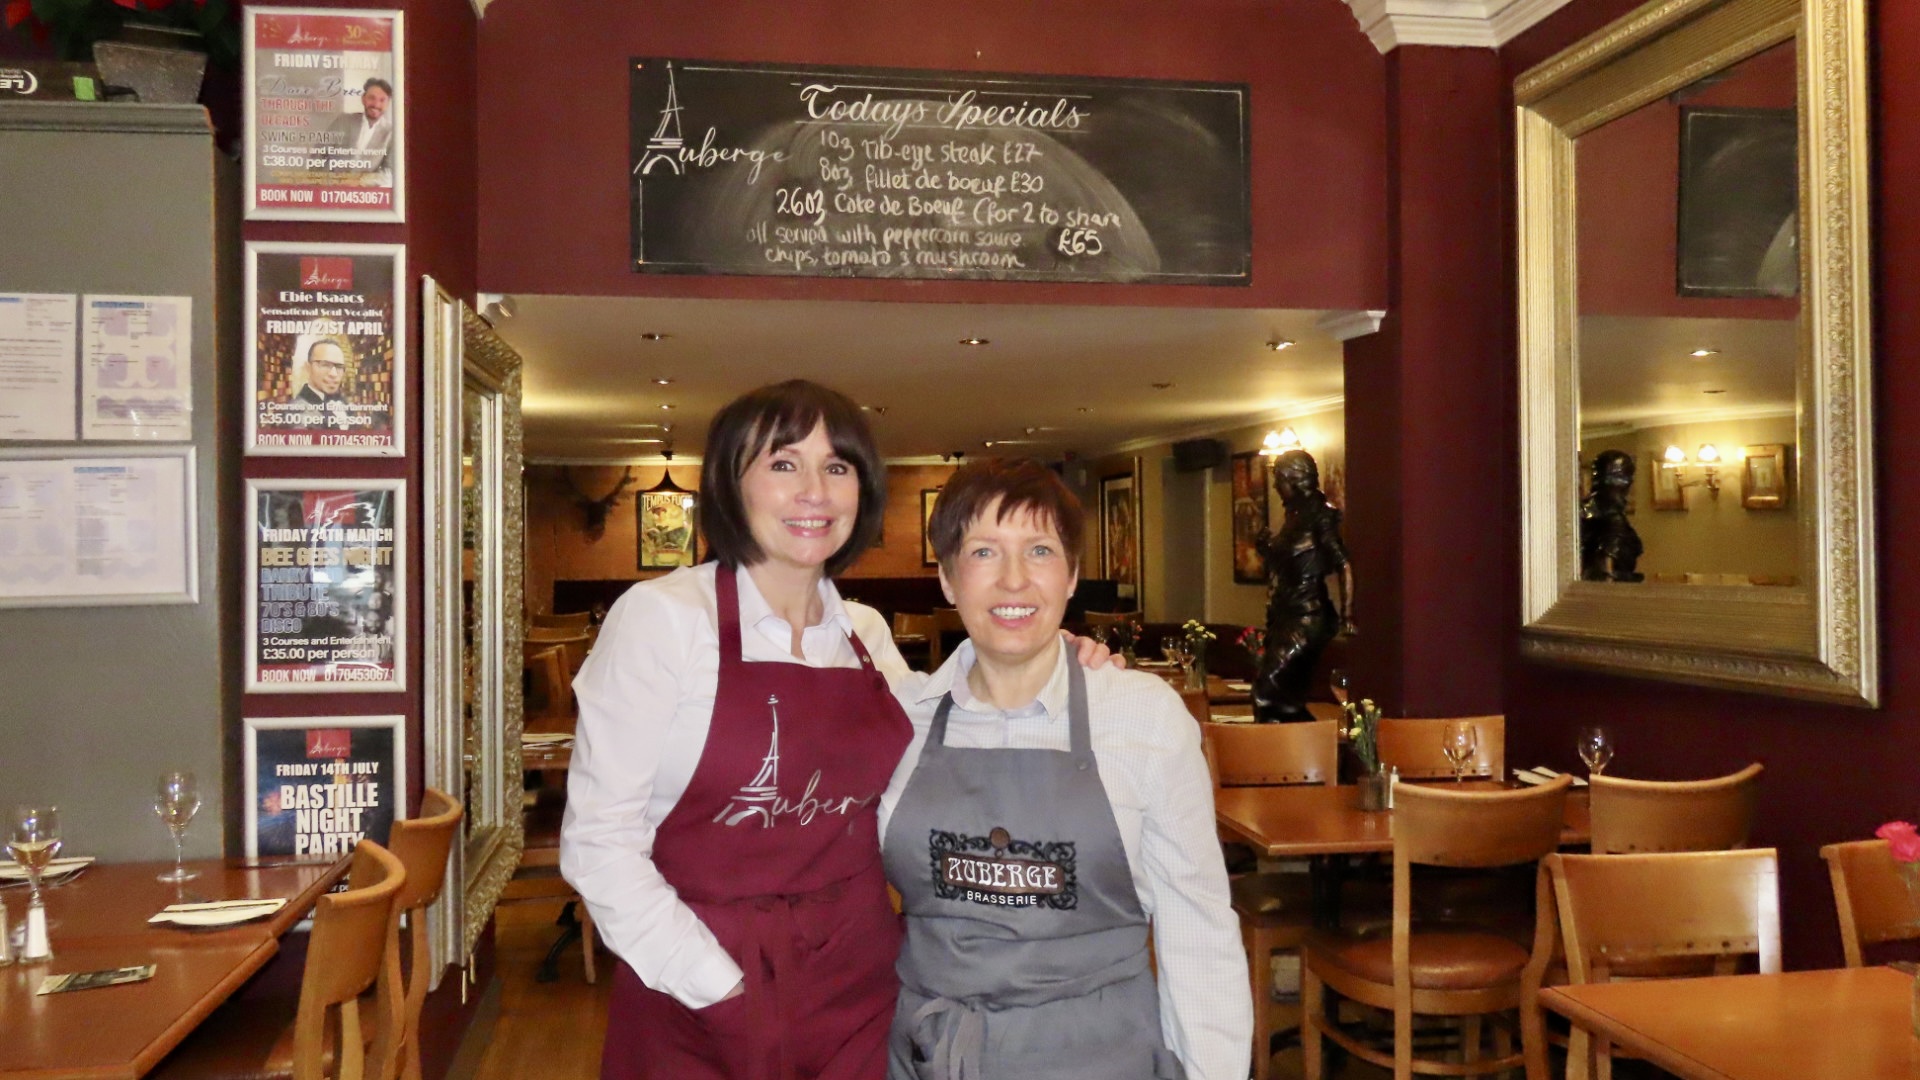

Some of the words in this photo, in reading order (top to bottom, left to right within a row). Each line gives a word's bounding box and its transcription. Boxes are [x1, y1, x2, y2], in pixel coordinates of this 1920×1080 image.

[274, 53, 320, 68] FRIDAY
[323, 54, 351, 69] 5TH
[261, 98, 310, 112] THROUGH
[313, 99, 334, 112] THE
[800, 84, 928, 140] Todays
[937, 89, 1090, 131] Specials
[261, 114, 310, 128] DECADES
[261, 130, 296, 143] SWING
[309, 131, 345, 144] PARTY
[263, 145, 269, 153] 3
[271, 144, 307, 154] Courses
[309, 145, 325, 155] and
[328, 146, 388, 157] Entertainment
[861, 137, 934, 171] rib-eye
[941, 141, 996, 165] steak
[263, 156, 303, 167] £38.00
[306, 158, 325, 170] per
[329, 159, 372, 170] person
[865, 164, 912, 192] fillet
[915, 168, 943, 190] de
[948, 171, 1006, 197] boeuf
[260, 188, 288, 202] BOOK
[290, 190, 314, 202] NOW
[321, 191, 390, 204] 01704530671
[880, 195, 903, 216] de
[908, 196, 965, 225] Boeuf
[973, 197, 1019, 226] (for
[1023, 202, 1036, 223] 2
[1040, 202, 1059, 226] to
[1066, 207, 1121, 228] share
[747, 221, 768, 244] all
[775, 226, 828, 245] served
[836, 224, 877, 245] with
[883, 227, 970, 250] peppercorn
[1058, 227, 1103, 256] £65
[824, 247, 891, 266] tomato
[916, 250, 1025, 268] mushroom
[280, 291, 314, 303] Ebie
[316, 291, 365, 304] Isaacs
[260, 307, 318, 317] Sensational
[320, 308, 343, 317] Soul
[344, 308, 384, 317] Vocalist
[266, 320, 312, 335] FRIDAY
[313, 320, 346, 336] 21ST
[347, 321, 384, 336] APRIL
[259, 402, 266, 411] 3
[267, 401, 306, 411] Courses
[308, 401, 325, 411] and
[327, 401, 388, 412] Entertainment
[259, 412, 301, 425] £35.00
[303, 415, 325, 427] per
[328, 414, 372, 427] person
[258, 434, 286, 446] BOOK
[289, 434, 312, 446] NOW
[320, 434, 391, 446] 01704530671
[263, 528, 308, 542] FRIDAY
[311, 528, 344, 542] 24TH
[347, 527, 393, 542] MARCH
[261, 547, 294, 566] BEE
[296, 547, 340, 566] GEES
[260, 583, 330, 601] TRIBUTE
[260, 618, 302, 633] DISCO
[263, 637, 269, 645] 3
[271, 637, 309, 645] Courses
[311, 636, 329, 645] and
[330, 636, 391, 645] Entertainment
[263, 648, 305, 659] £35.00
[307, 649, 329, 662] per
[332, 649, 376, 661] person
[261, 669, 290, 682] BOOK
[292, 669, 317, 682] NOW
[324, 668, 395, 682] 01704530671
[276, 763, 318, 777] FRIDAY
[321, 763, 350, 775] 14TH
[352, 762, 379, 774] JULY
[280, 782, 379, 809] BASTILLE
[296, 808, 363, 834] NIGHT
[295, 832, 365, 855] PARTY
[948, 856, 1059, 889] AUBERGE
[967, 890, 1037, 906] BRASSERIE
